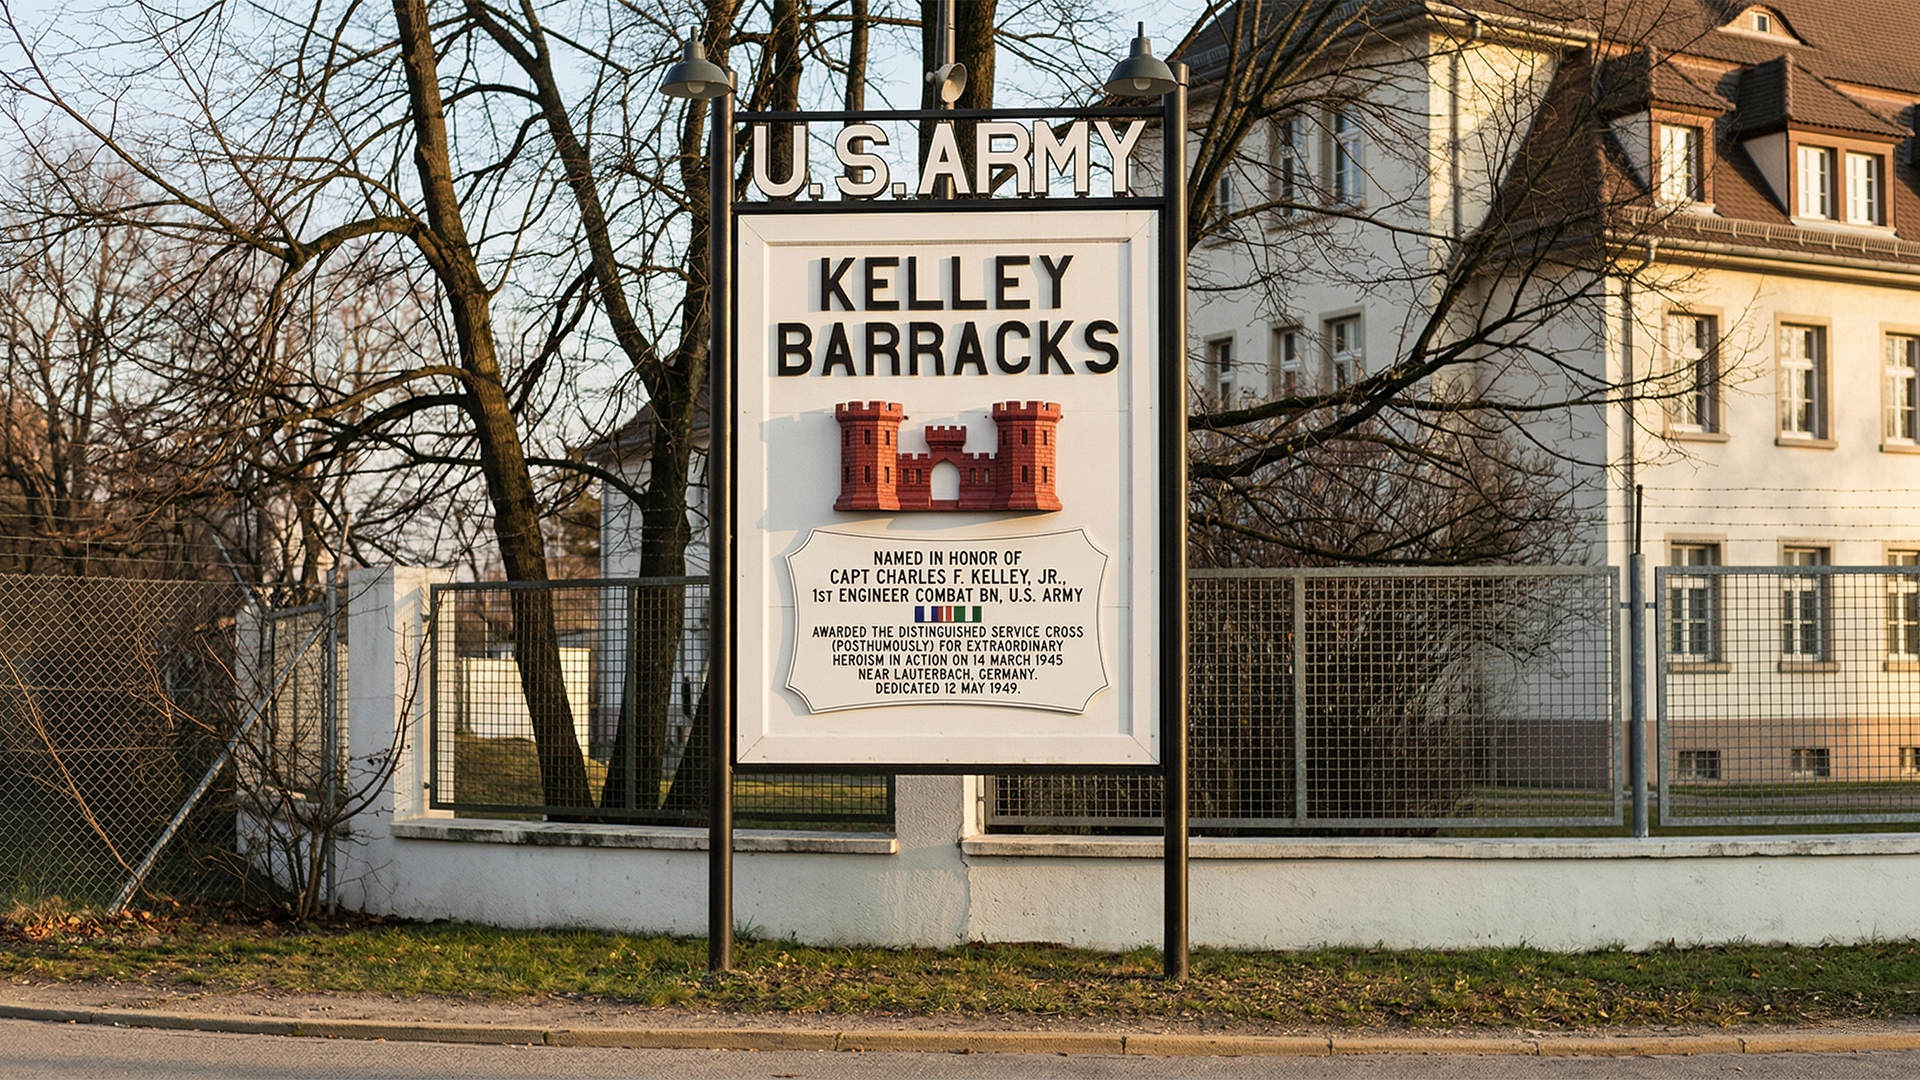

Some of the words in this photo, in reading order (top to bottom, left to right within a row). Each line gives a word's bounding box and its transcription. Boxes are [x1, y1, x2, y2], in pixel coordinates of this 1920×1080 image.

[821, 256, 1073, 311] KELLEY
[778, 320, 1118, 376] BARRACKS
[874, 551, 923, 565] NAMED
[930, 551, 943, 565] IN
[950, 551, 997, 565] HONOR
[1004, 551, 1022, 565] OF
[831, 569, 869, 584] CAPT
[877, 569, 946, 584] CHARLES
[954, 569, 964, 584] F.
[972, 569, 1031, 586] KELLEY,
[1038, 569, 1066, 585] JR.,
[840, 588, 909, 602] ENGINEER
[916, 588, 973, 602] COMBAT
[980, 588, 1002, 604] BN,
[1010, 588, 1036, 602] U.S.
[1043, 588, 1083, 602] ARMY
[812, 626, 866, 637] AWARDED
[872, 626, 893, 637] THE
[899, 626, 986, 638] DISTINGUISHED
[992, 626, 1040, 638] SERVICE
[1046, 626, 1083, 638] CROSS
[832, 640, 934, 652] (POSTHUMOUSLY)
[940, 640, 961, 652] FOR
[967, 640, 1063, 652] EXTRAORDINARY
[833, 654, 884, 666] HEROISM
[890, 654, 900, 665] IN
[906, 654, 947, 666] ACTION
[953, 654, 968, 666] ON
[973, 654, 985, 665] 14
[991, 654, 1030, 666] MARCH
[1036, 654, 1063, 665] 1945
[859, 668, 889, 680] NEAR
[895, 668, 974, 681] LAUTERBACH,
[979, 668, 1037, 680] GERMANY.
[876, 682, 939, 694] DEDICATED
[945, 683, 956, 694] 12
[962, 682, 985, 694] MAY
[990, 683, 1020, 694] 1949.
